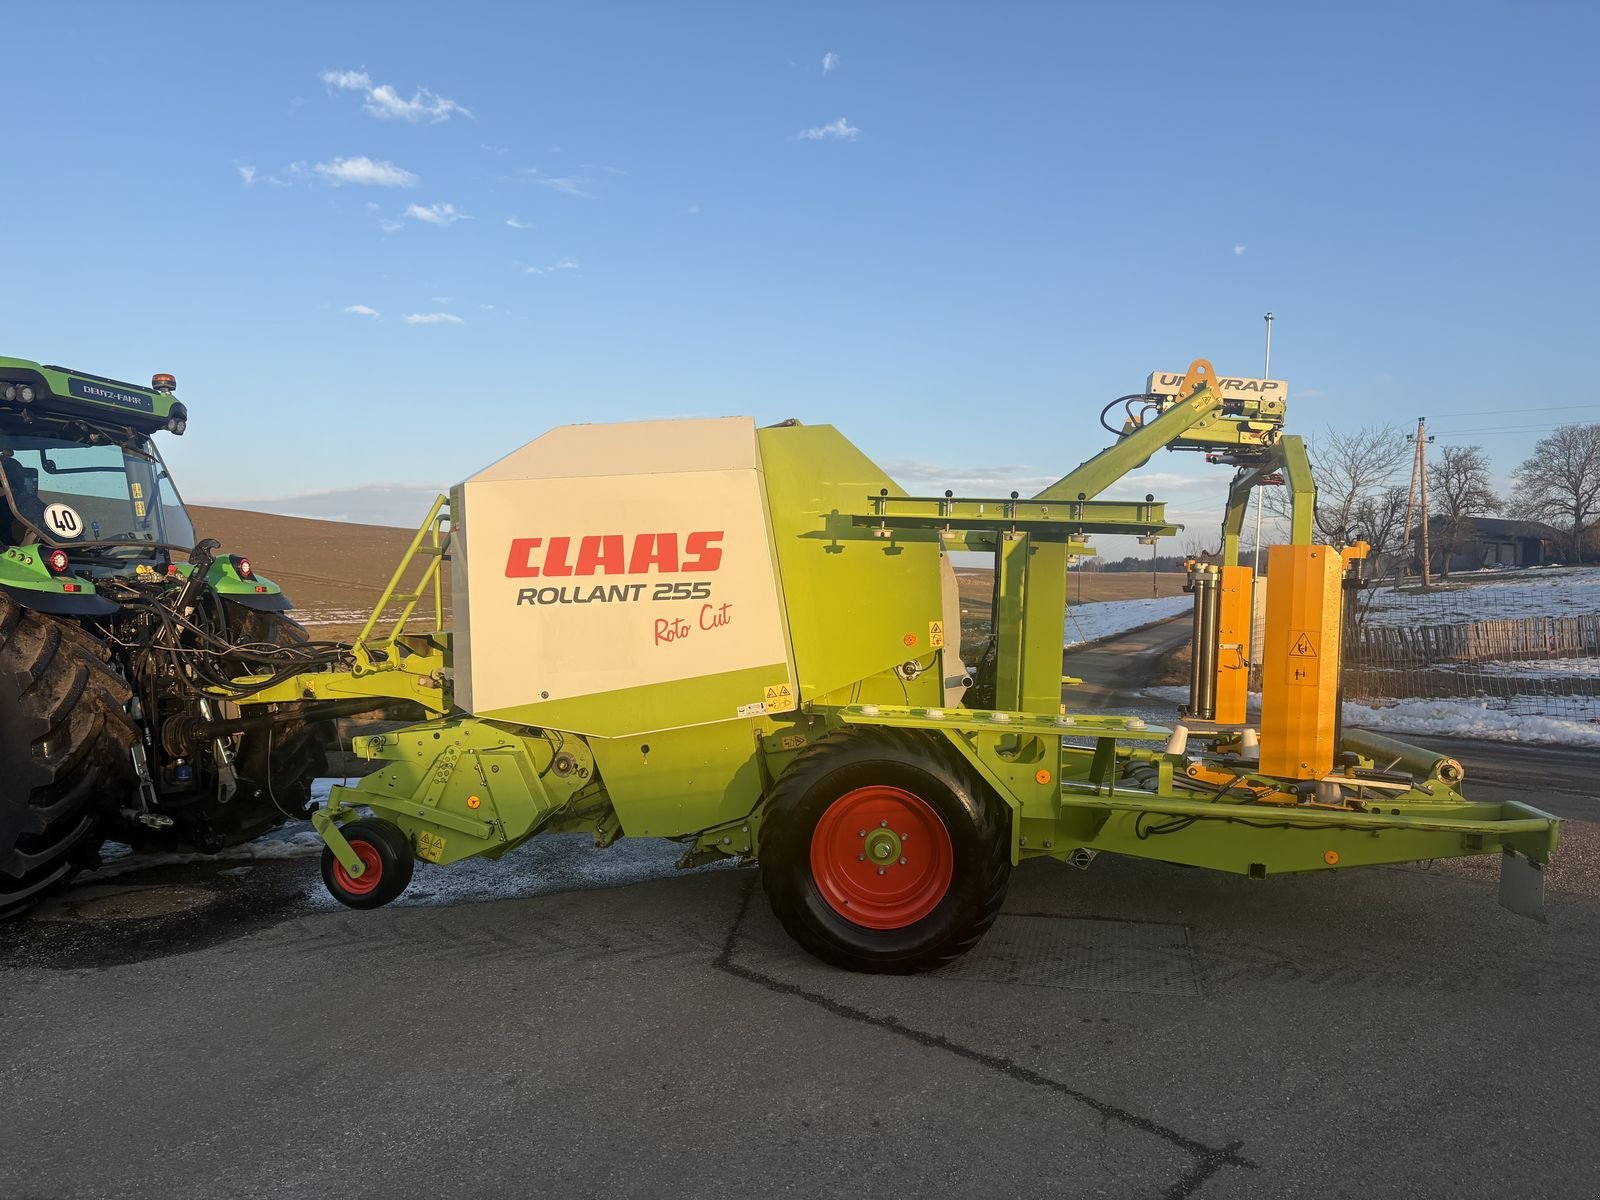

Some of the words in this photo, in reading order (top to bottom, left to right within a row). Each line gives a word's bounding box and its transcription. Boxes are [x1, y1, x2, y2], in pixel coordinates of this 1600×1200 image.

[83, 385, 141, 404] DEUTZ-FAHR
[52, 510, 77, 531] 40
[505, 531, 724, 577] CLAAS
[517, 584, 647, 606] ROLLANT
[652, 582, 711, 600] 255
[655, 618, 691, 646] Roto
[700, 603, 733, 630] Cut
